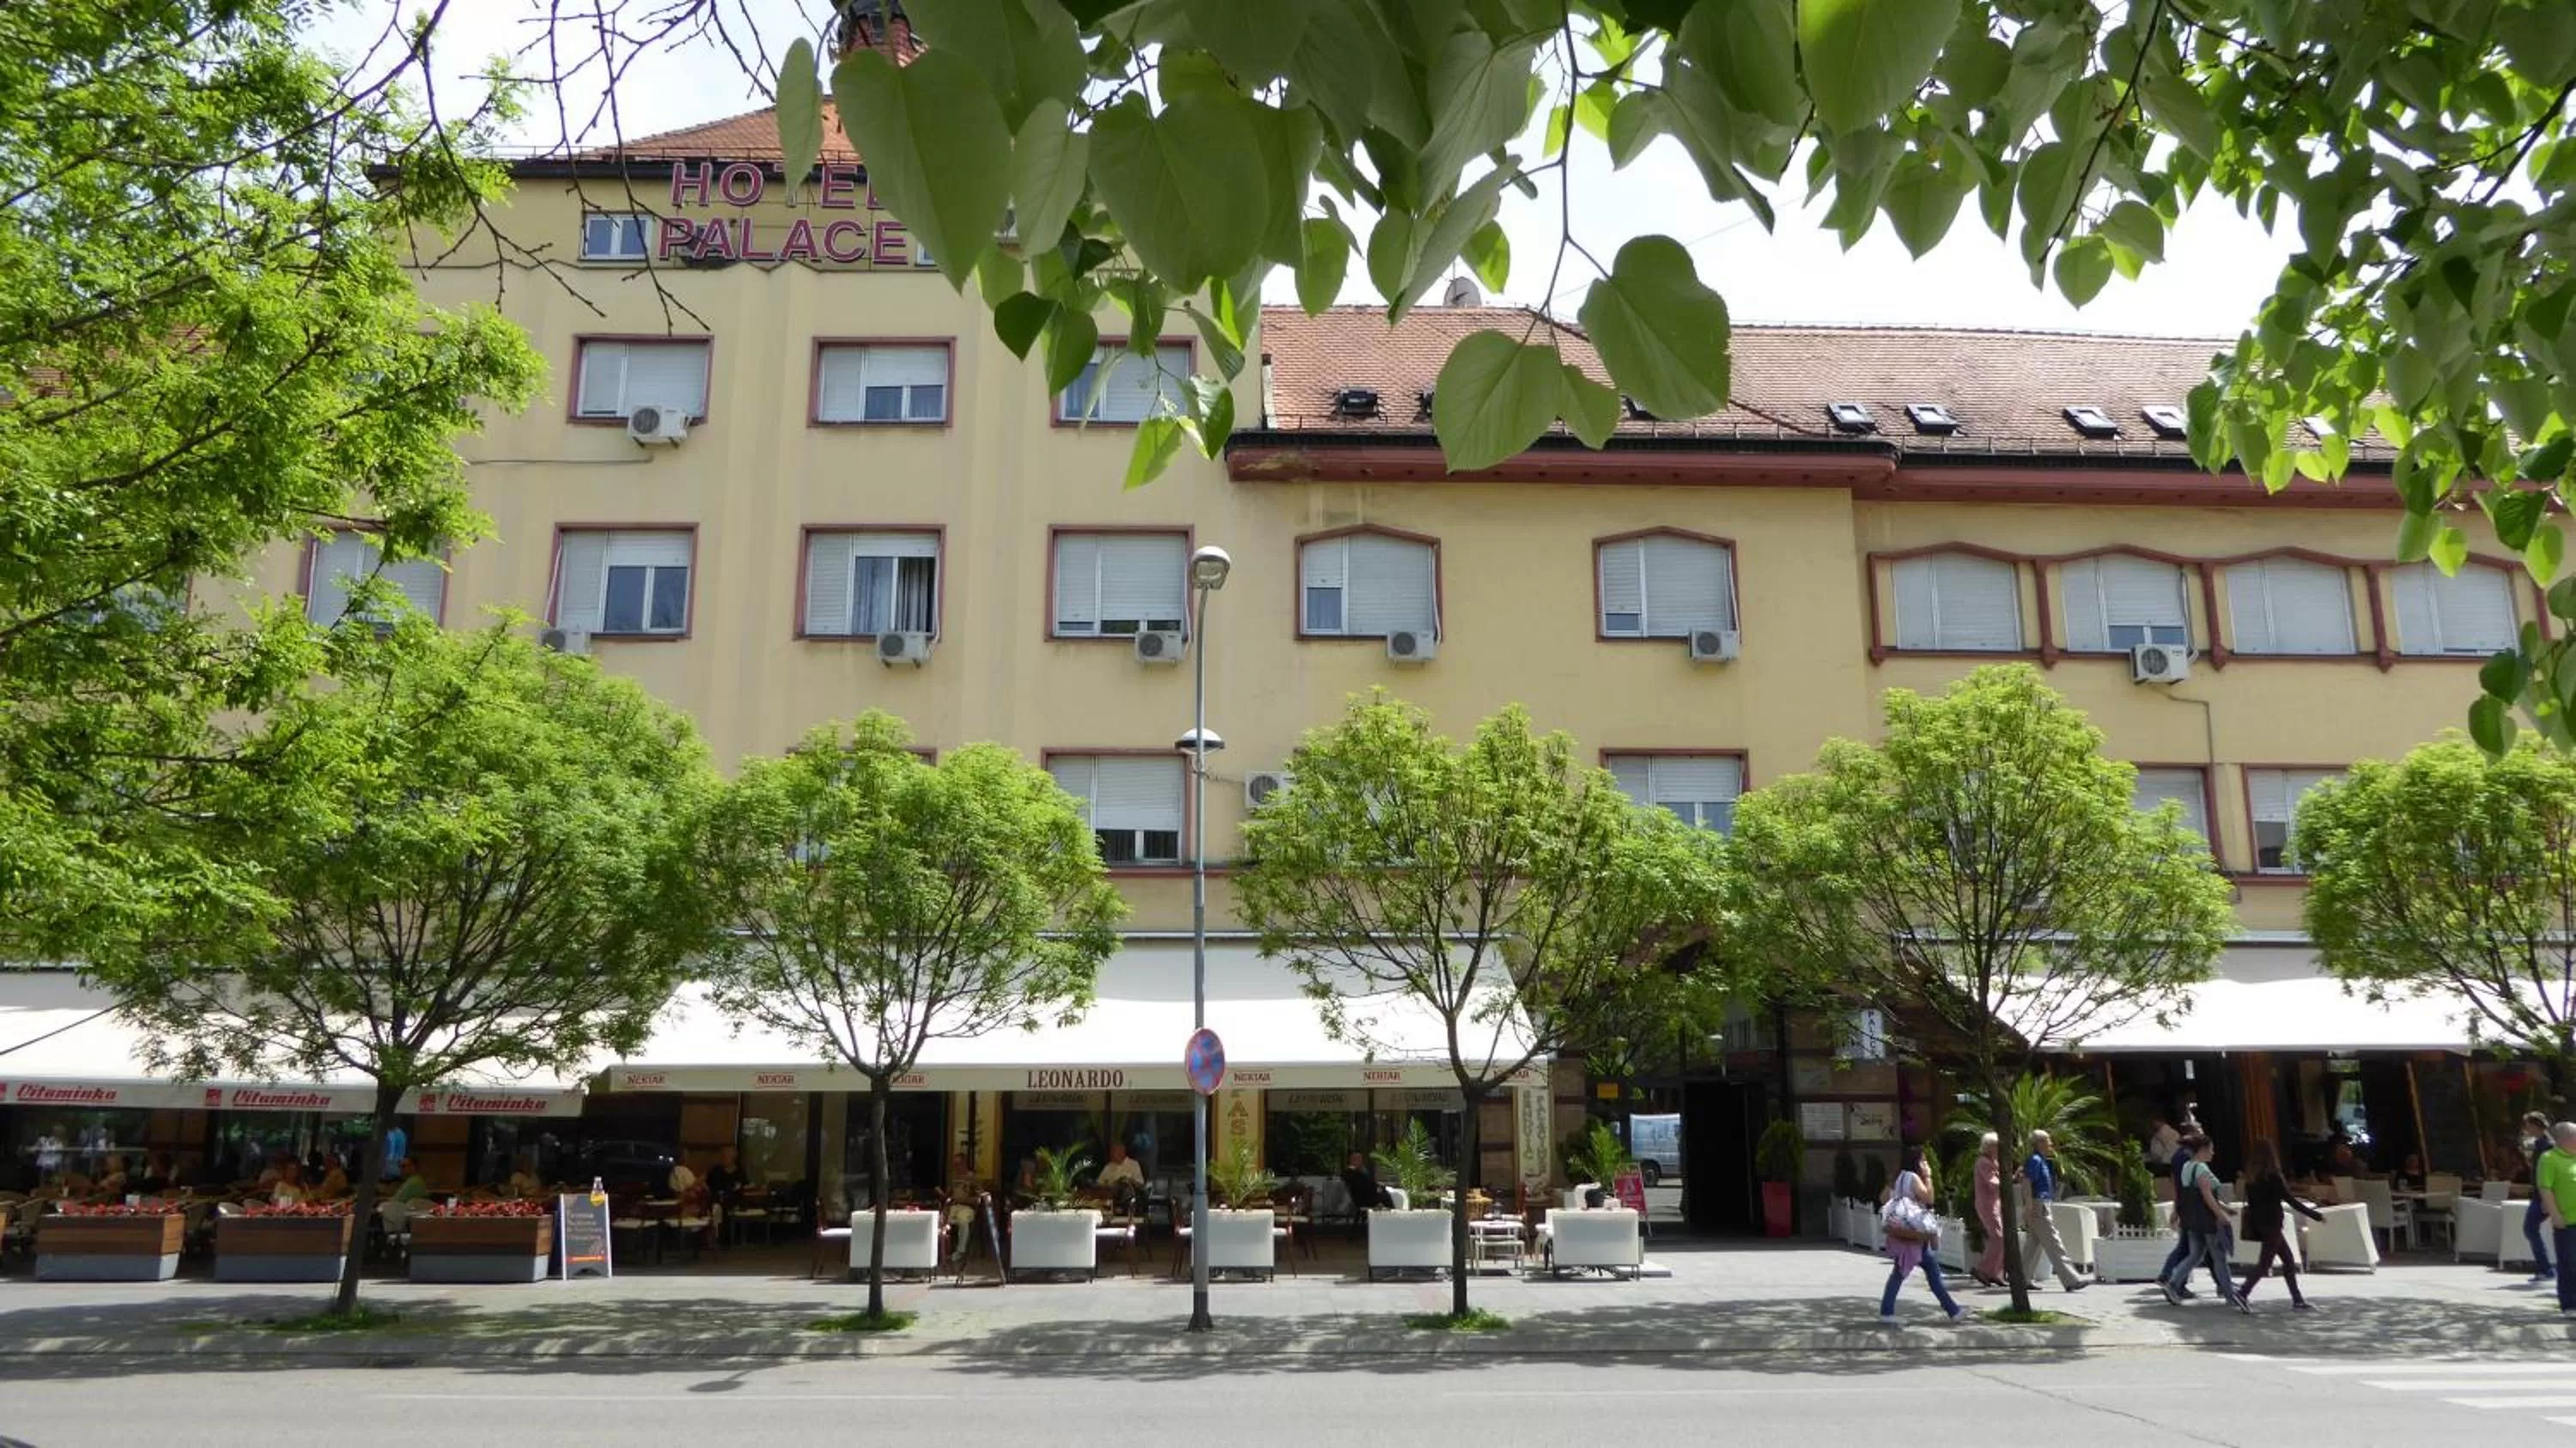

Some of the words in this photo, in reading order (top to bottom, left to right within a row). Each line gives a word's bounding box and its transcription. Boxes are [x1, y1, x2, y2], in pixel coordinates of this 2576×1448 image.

[671, 162, 883, 208] HOE
[658, 216, 908, 265] PALACE
[757, 1074, 794, 1085] NEKTAR
[1026, 1069, 1124, 1088] LEONARDO
[1234, 1072, 1271, 1082] NEKTAR
[1364, 1071, 1401, 1081] NEKTAR
[16, 1083, 118, 1100] Vitaminka
[233, 1088, 331, 1107] Vitaminka
[447, 1093, 549, 1111] Vitaminka
